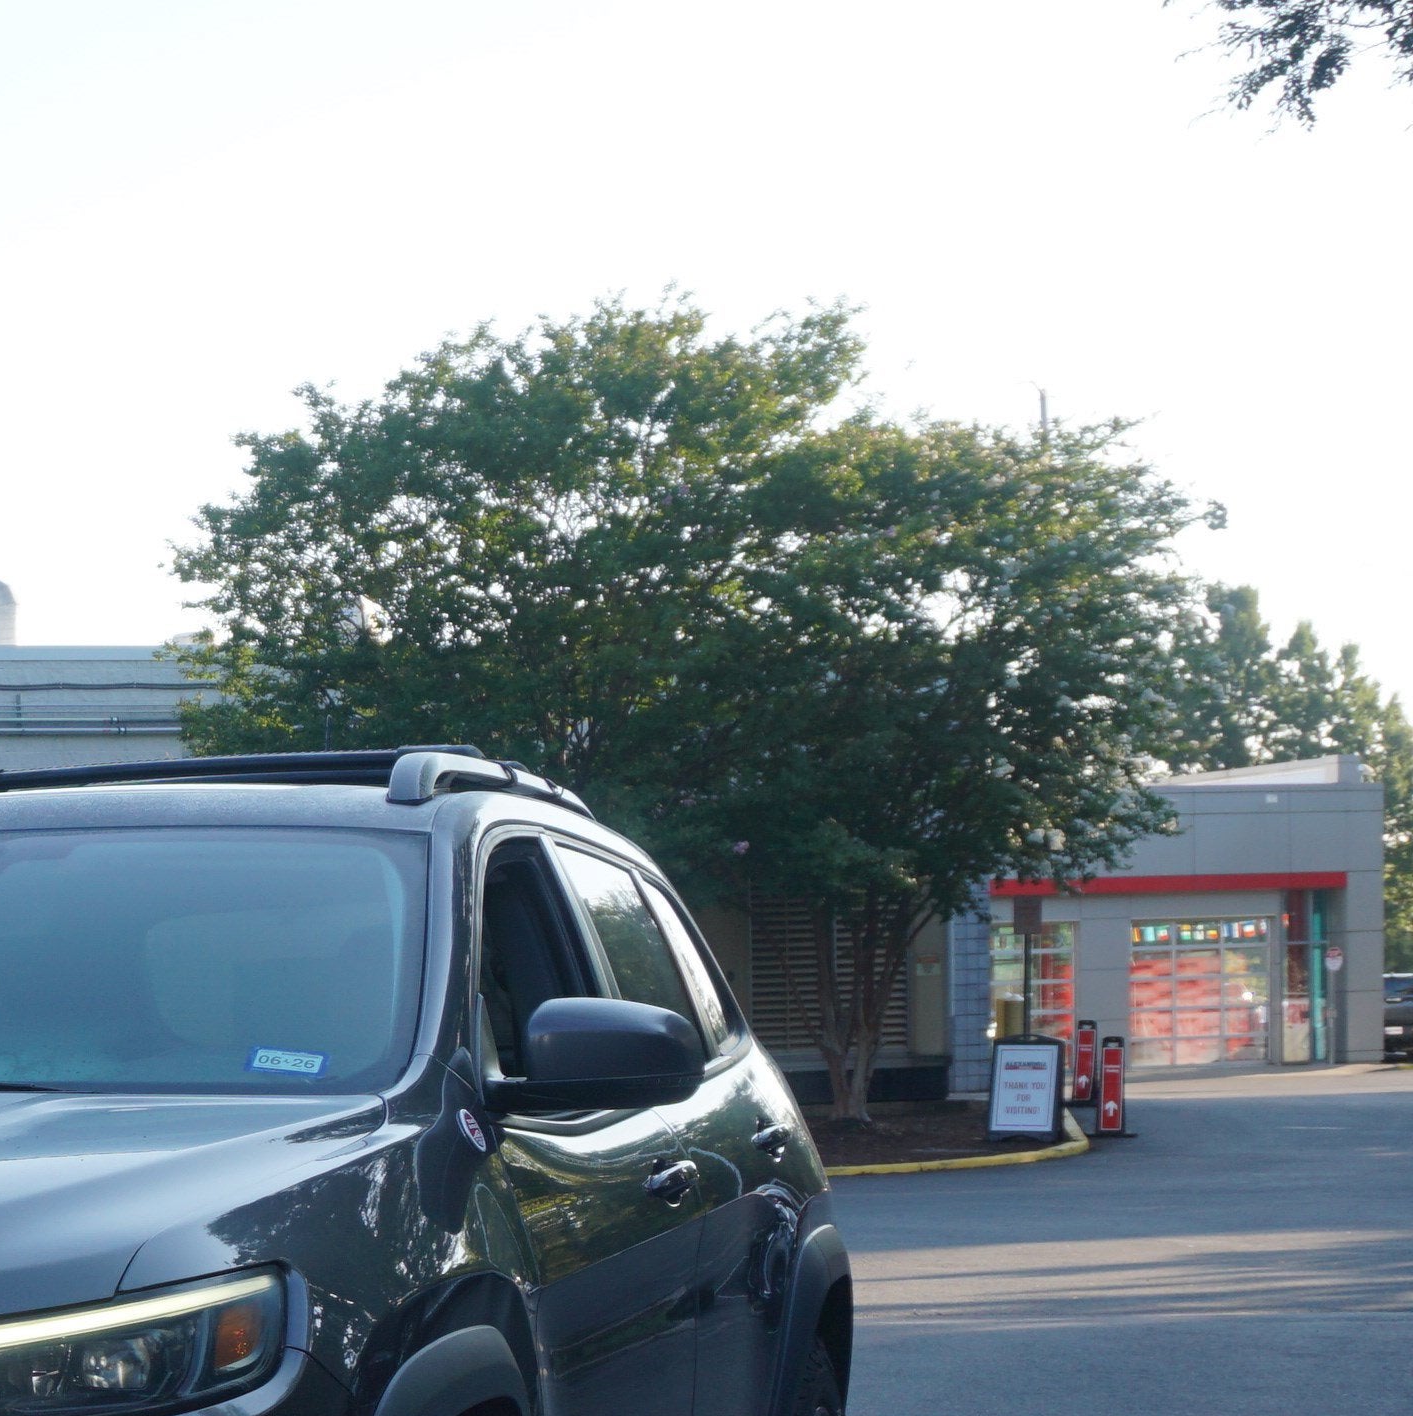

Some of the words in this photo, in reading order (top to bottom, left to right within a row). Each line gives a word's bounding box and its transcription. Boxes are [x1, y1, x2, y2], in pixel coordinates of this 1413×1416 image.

[1004, 1081, 1028, 1089] THANK
[1032, 1081, 1046, 1090] YOU
[1017, 1094, 1031, 1102] FOR
